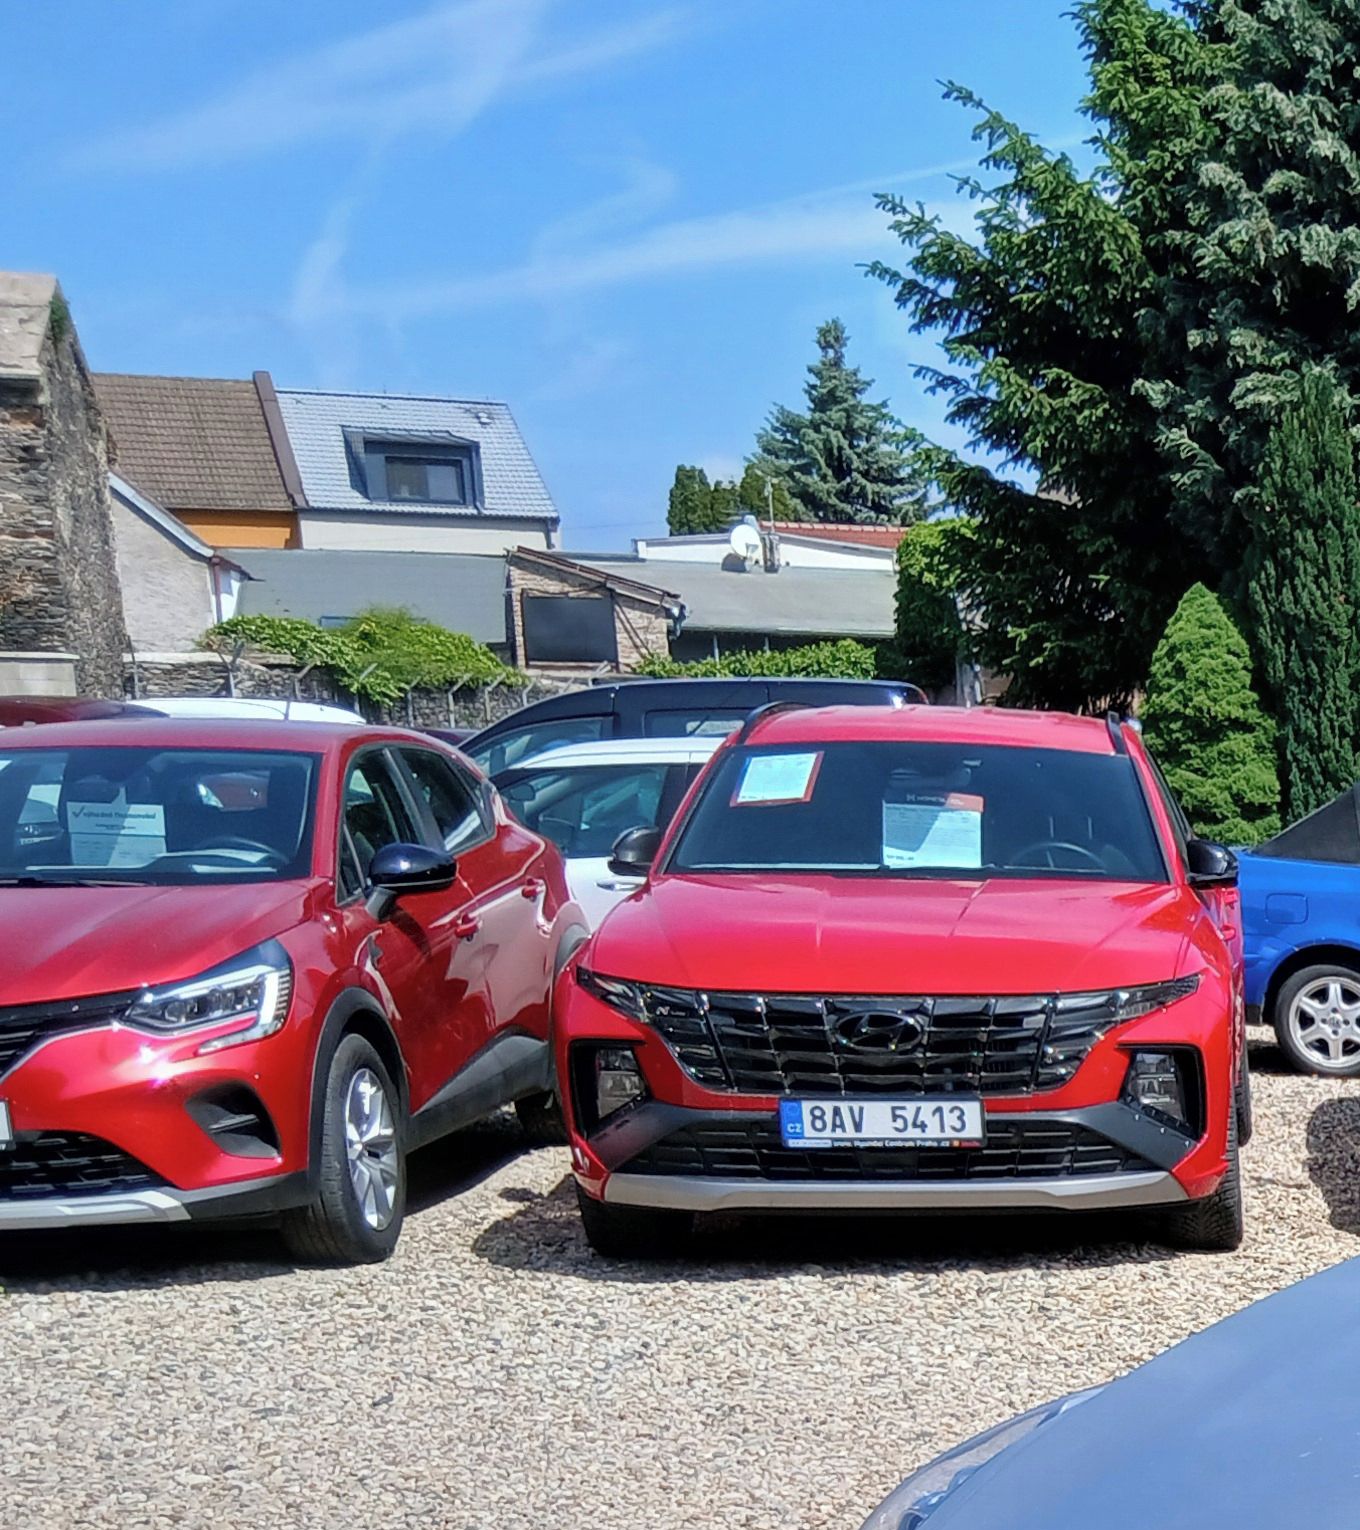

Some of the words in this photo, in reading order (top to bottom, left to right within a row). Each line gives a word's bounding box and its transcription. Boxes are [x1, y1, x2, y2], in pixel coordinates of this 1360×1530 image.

[787, 1123, 802, 1133] CZ
[809, 1105, 864, 1133] 8AV
[890, 1105, 967, 1133] 5413
